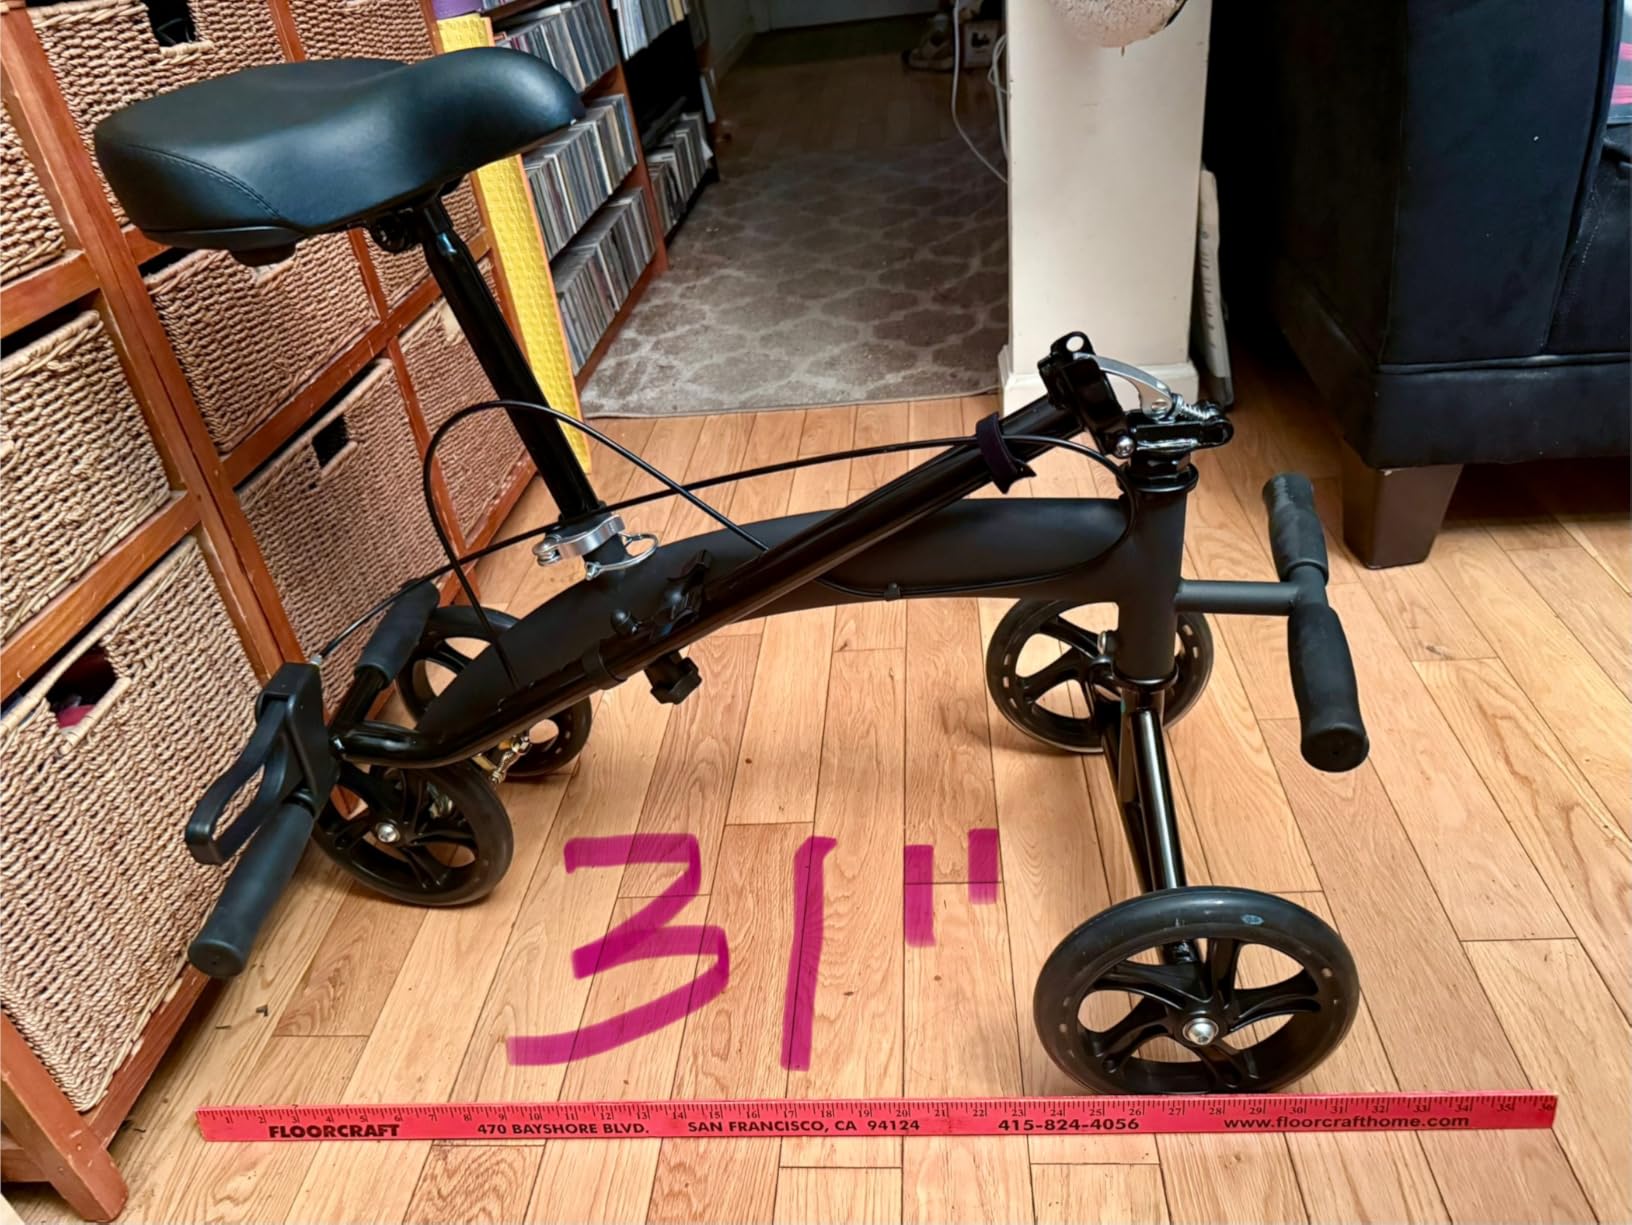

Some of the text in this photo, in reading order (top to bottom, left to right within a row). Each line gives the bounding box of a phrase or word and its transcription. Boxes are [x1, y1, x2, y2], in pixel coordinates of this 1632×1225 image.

[601, 1112, 611, 1120] 12
[709, 1111, 721, 1119] 15
[896, 1109, 908, 1117] 20
[935, 1109, 946, 1117] 21
[973, 1109, 985, 1117] 22
[1012, 1109, 1024, 1117] 23
[1050, 1109, 1063, 1117] 24
[1090, 1109, 1102, 1117] 25
[1129, 1108, 1142, 1116] 26
[1209, 1107, 1222, 1115] 28
[1290, 1106, 1303, 1114] 30
[1372, 1105, 1385, 1113] 32
[1413, 1104, 1427, 1112] 33
[1455, 1104, 1469, 1112] 34
[268, 1115, 1469, 1138] FLOORCRAFT 470 BAYSHORE BLVD. SAN FRANCISCO, CA 94124 415-824-4056 www.floorcrafthome.com
